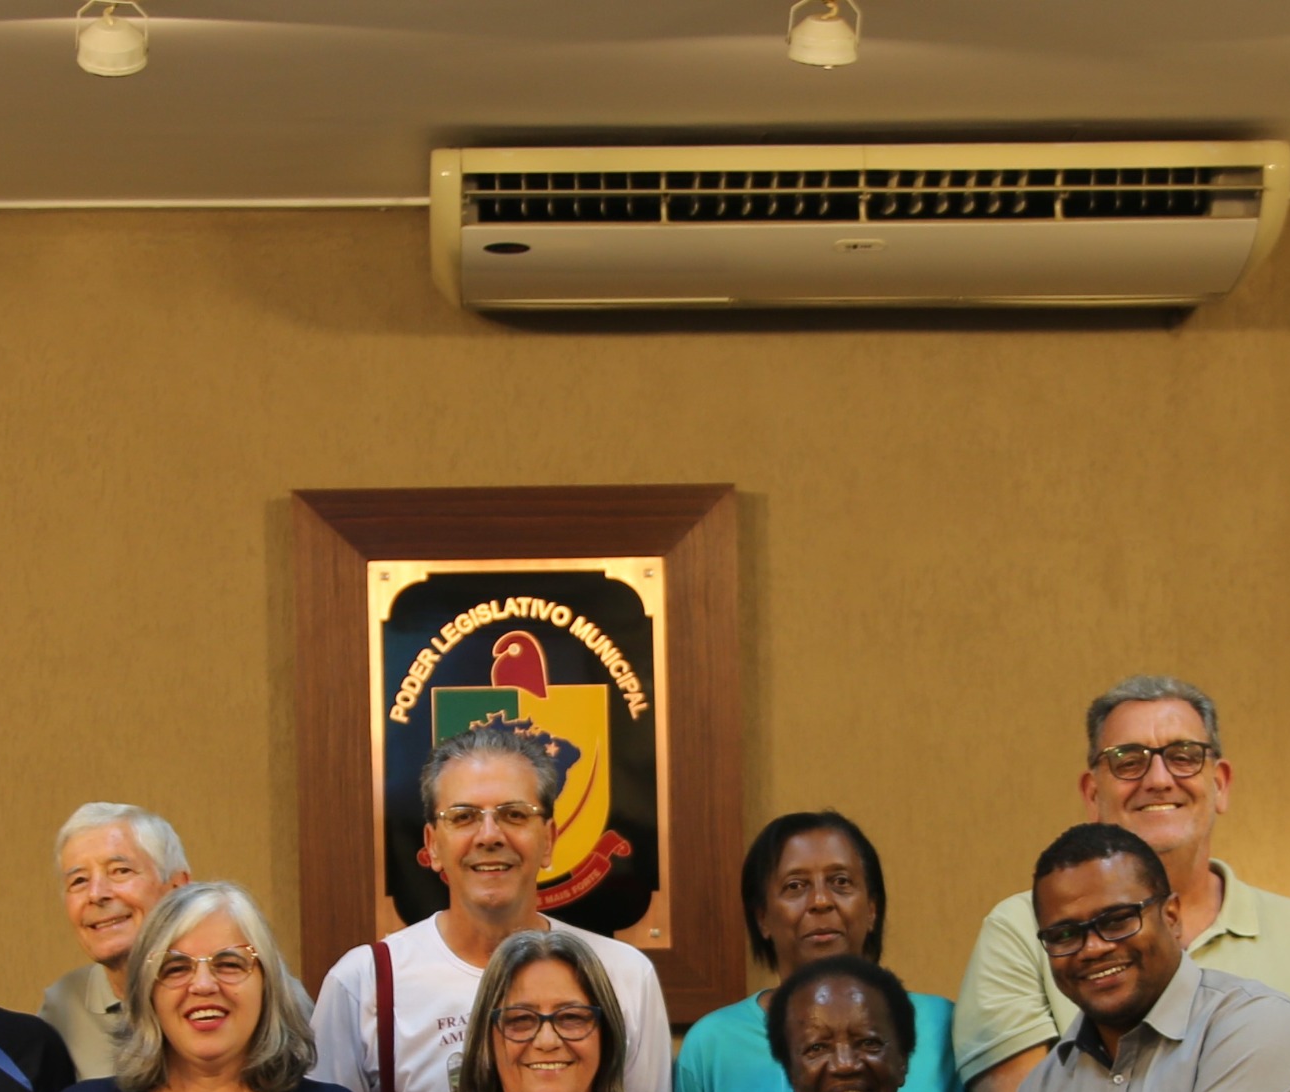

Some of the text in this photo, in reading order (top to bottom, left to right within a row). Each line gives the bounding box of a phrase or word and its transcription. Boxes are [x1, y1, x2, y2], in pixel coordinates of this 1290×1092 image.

[389, 597, 649, 724] PODER LEGISLATIVO MUNICIPAL
